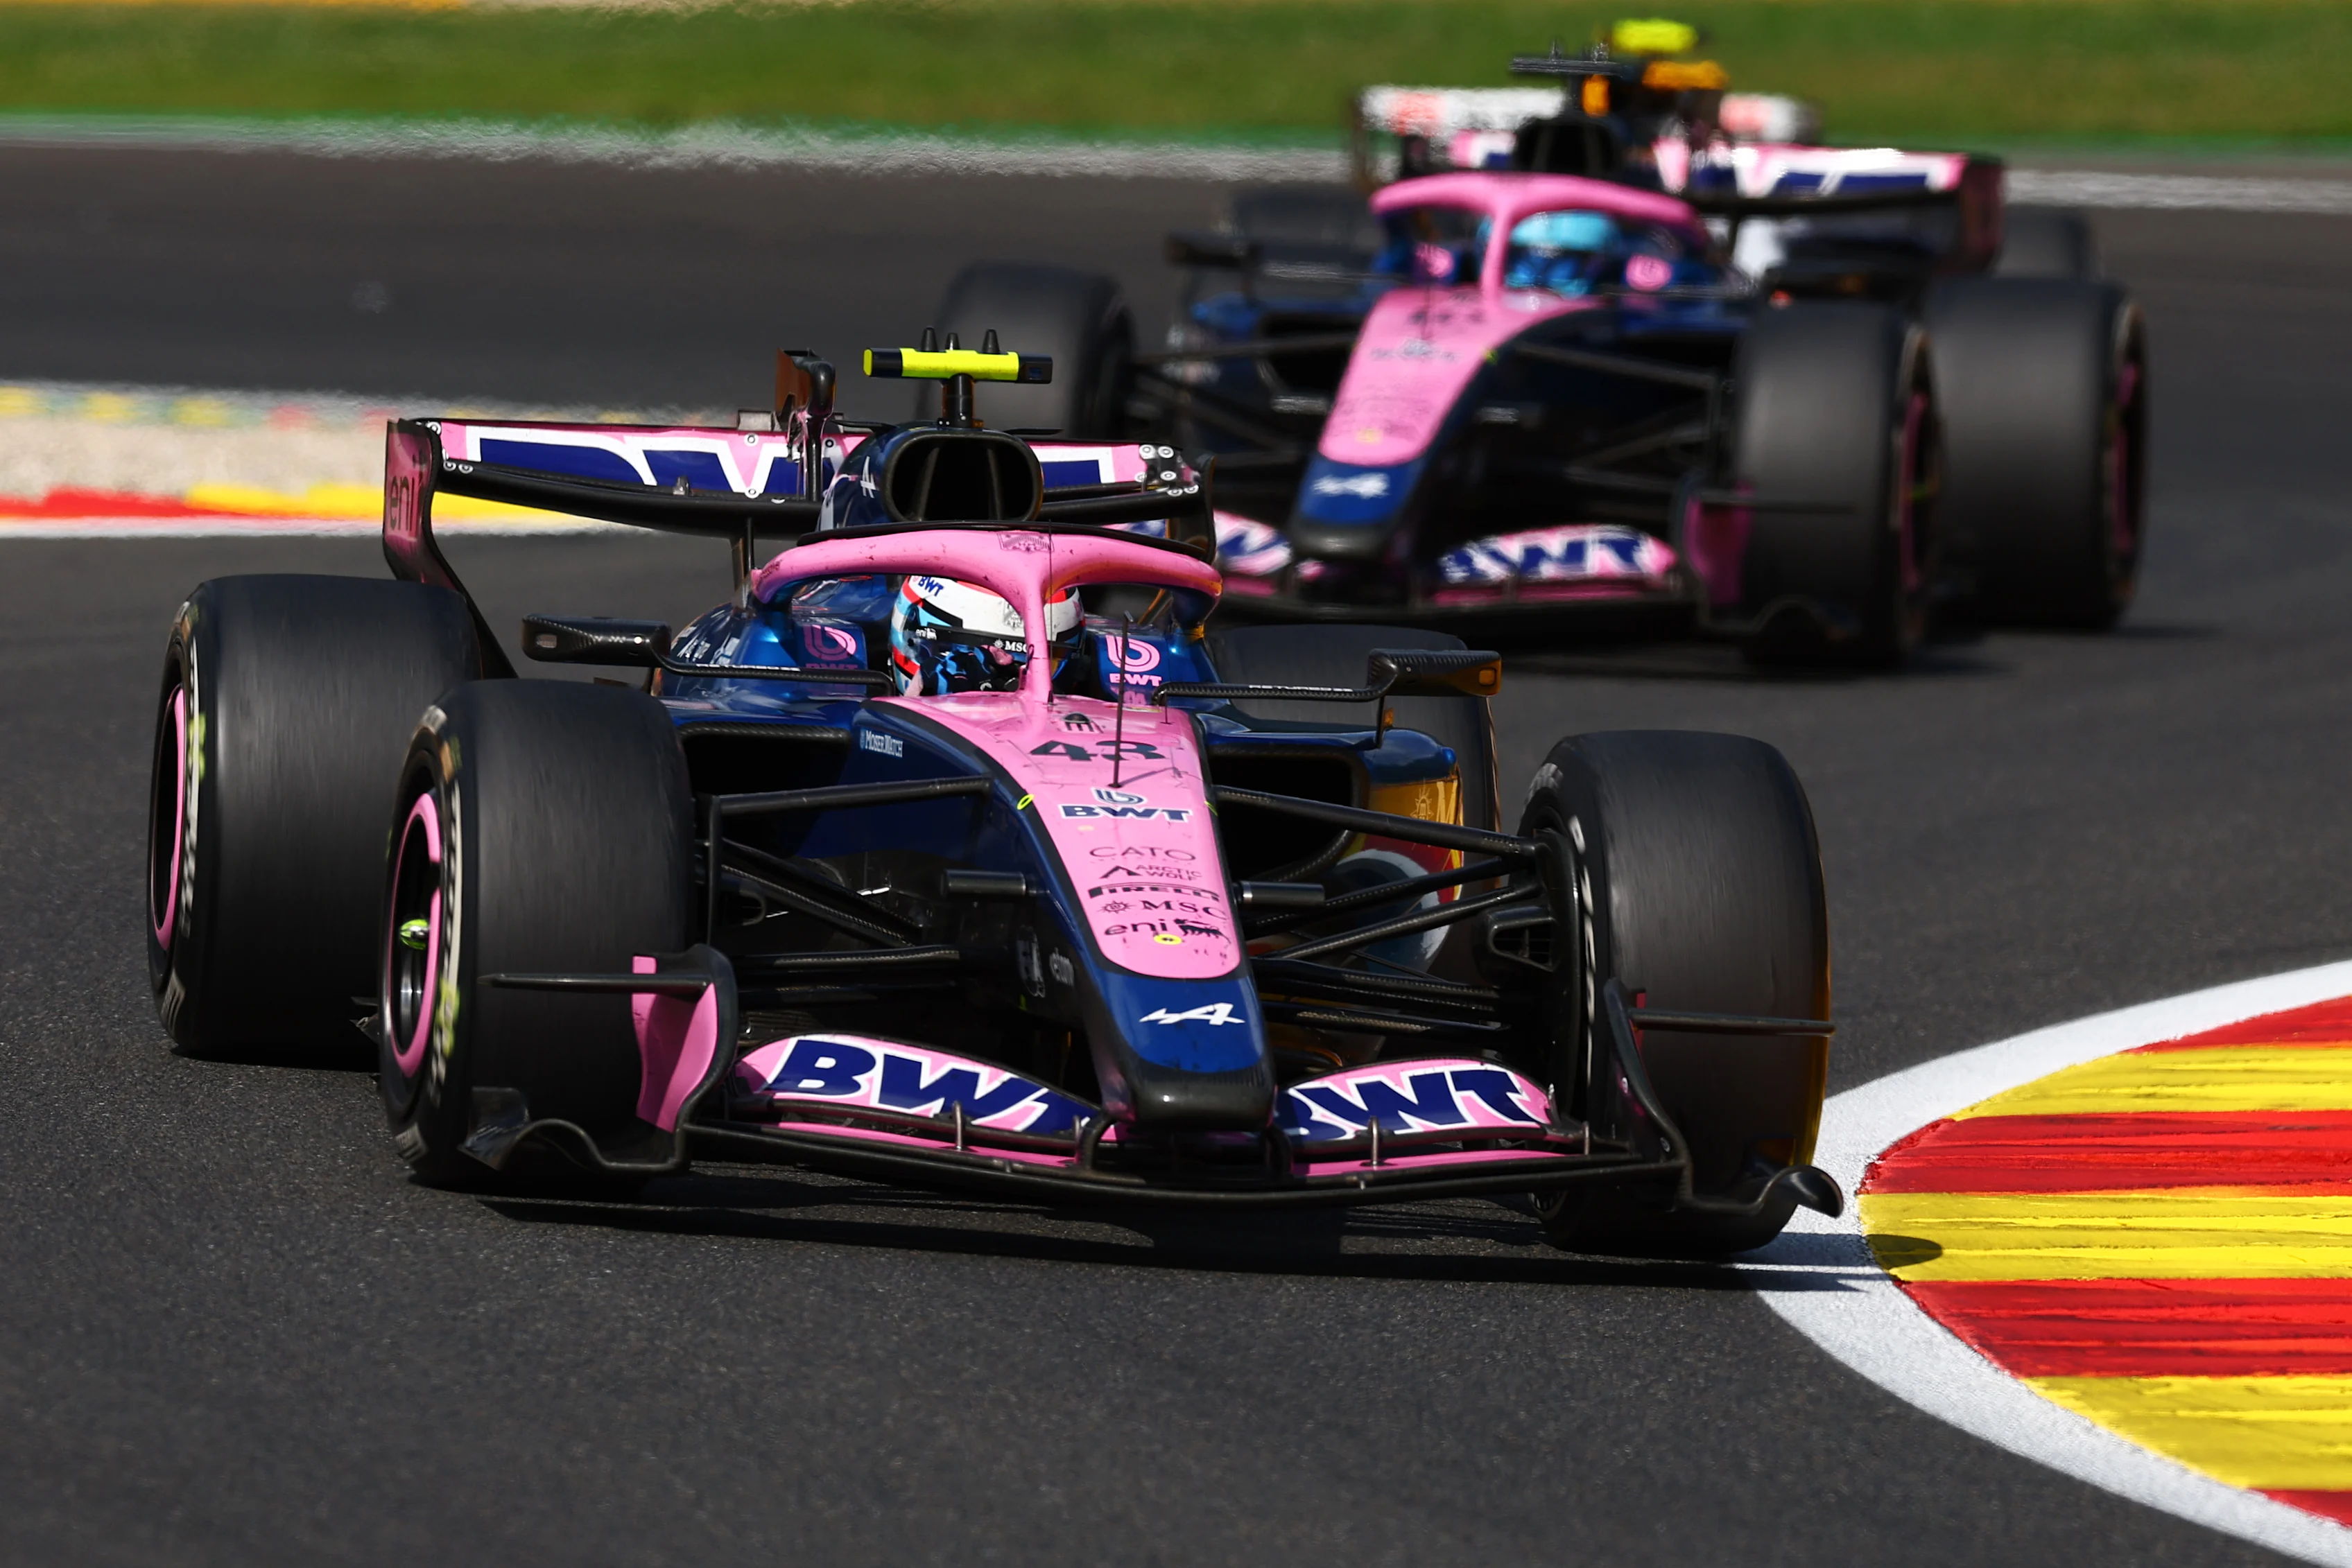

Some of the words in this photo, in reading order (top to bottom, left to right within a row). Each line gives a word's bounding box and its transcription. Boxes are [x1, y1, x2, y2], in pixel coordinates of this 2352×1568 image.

[918, 576, 944, 597] BWT
[1109, 673, 1162, 687] BWT
[1029, 740, 1166, 761] 43
[1061, 805, 1191, 822] BWT
[1089, 846, 1196, 861] CATO
[1136, 864, 1202, 878] ARCTIC
[1145, 871, 1198, 881] WOLF
[1139, 900, 1230, 921] MSC
[1104, 918, 1168, 936] eni
